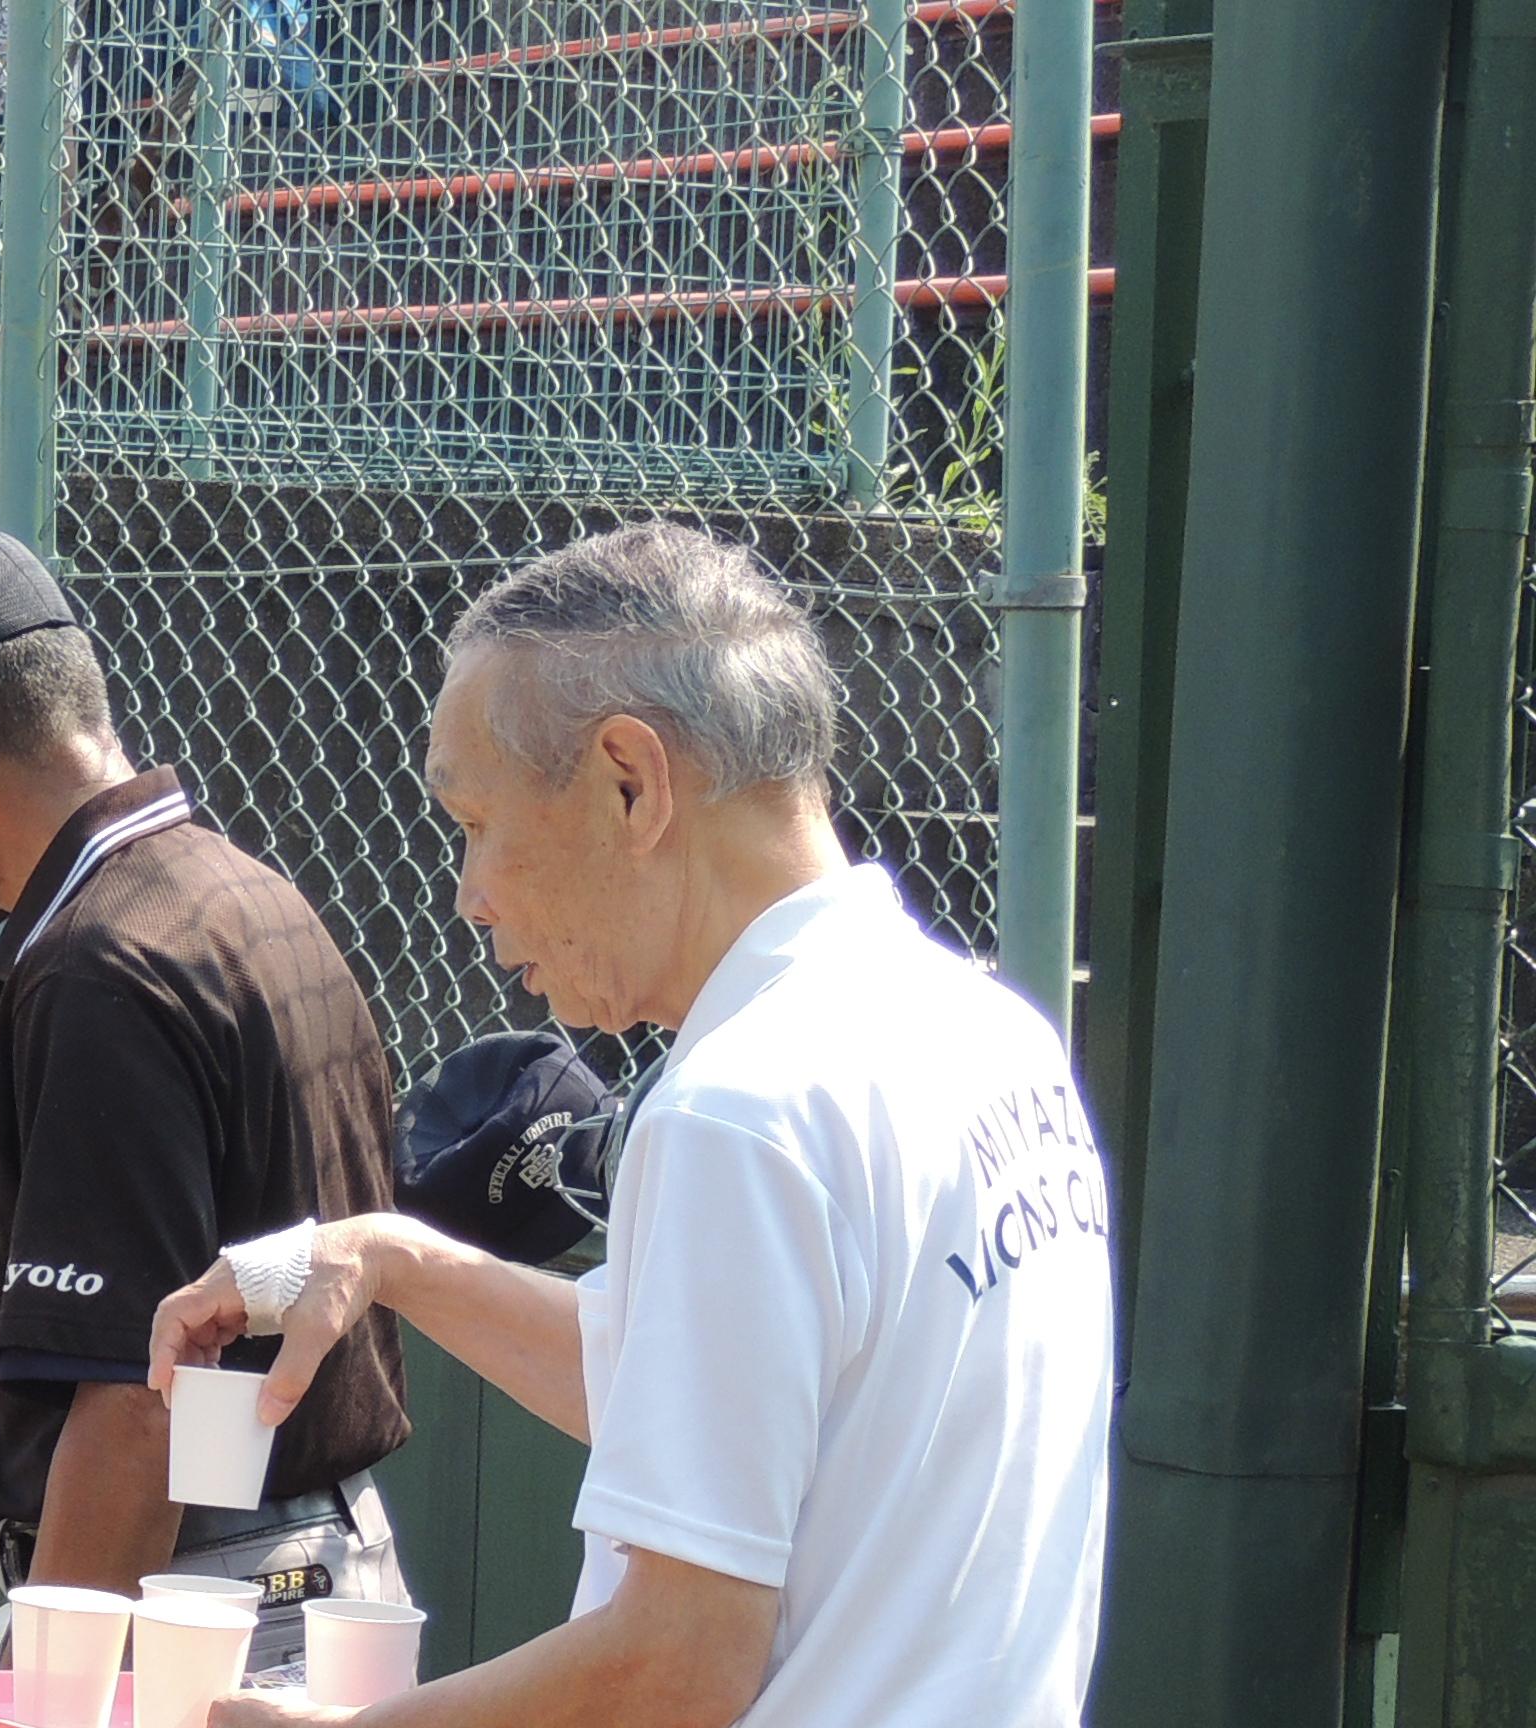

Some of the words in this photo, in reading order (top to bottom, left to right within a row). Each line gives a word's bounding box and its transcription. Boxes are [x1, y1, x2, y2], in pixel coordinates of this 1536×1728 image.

[488, 1143, 526, 1205] OFFICIAL
[519, 1111, 574, 1145] UMPIRE
[944, 1174, 1058, 1308] LIONS
[259, 1587, 306, 1605] MPIRE
